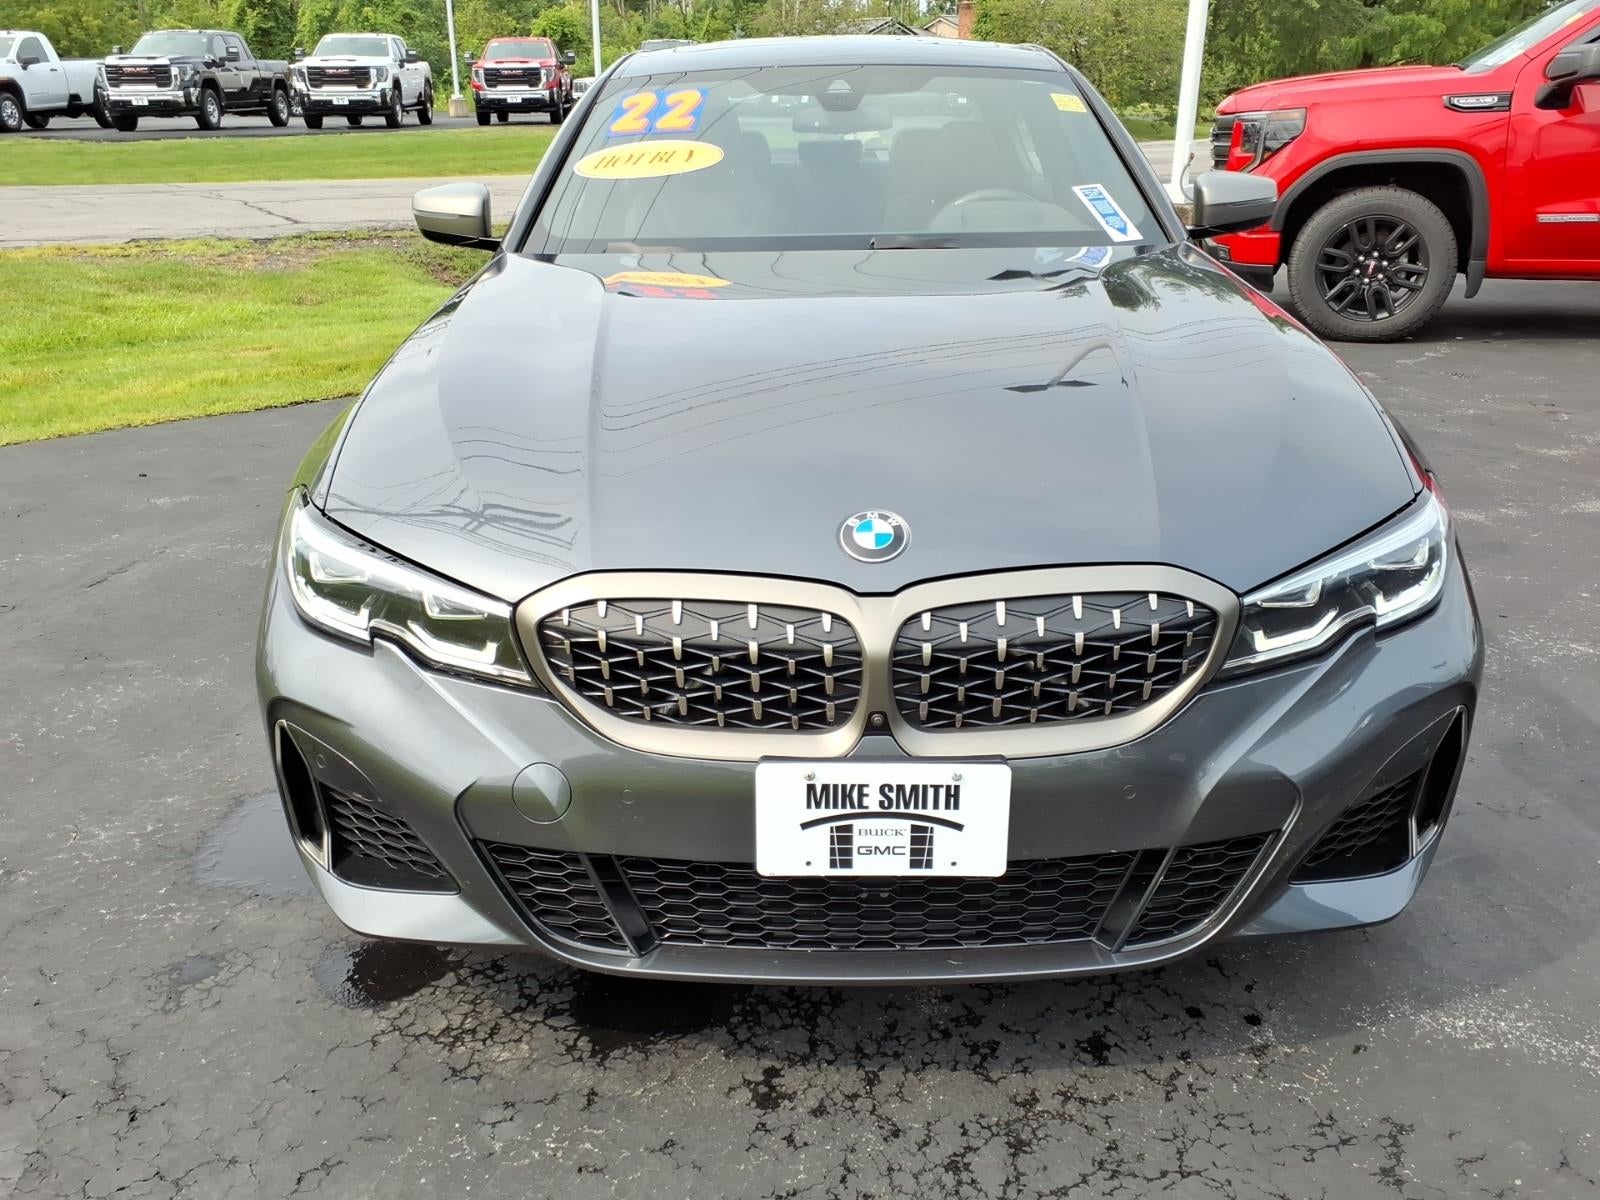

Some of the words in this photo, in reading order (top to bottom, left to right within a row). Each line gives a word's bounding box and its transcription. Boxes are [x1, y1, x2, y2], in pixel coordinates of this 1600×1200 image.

[610, 89, 703, 133] 22
[847, 511, 901, 527] BMW
[806, 783, 869, 810] MIKE
[878, 783, 961, 811] SMITH
[858, 828, 905, 837] BUICK
[857, 845, 906, 856] GMC
